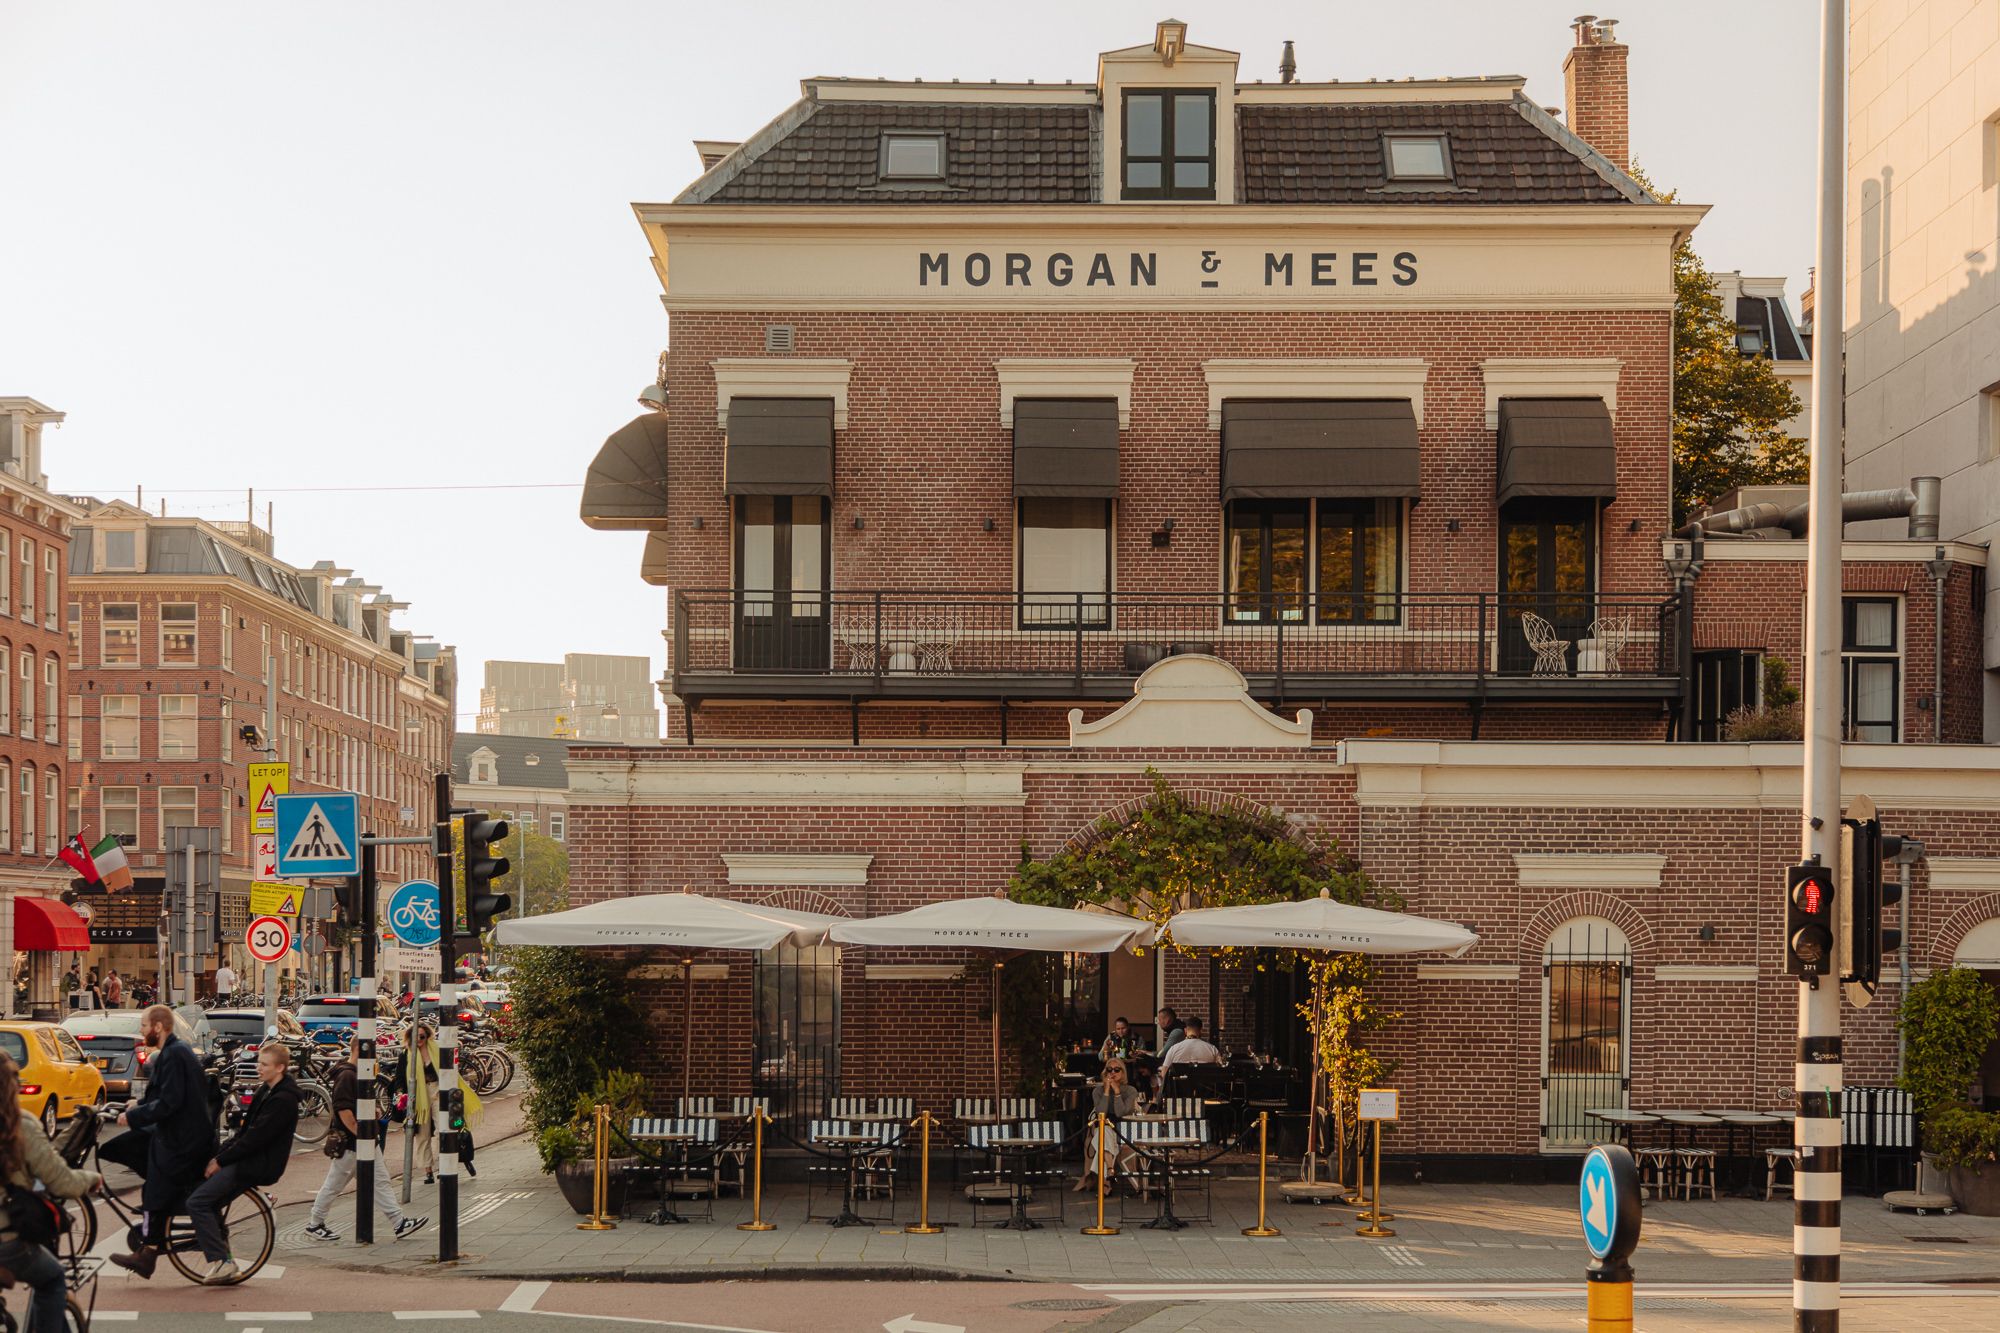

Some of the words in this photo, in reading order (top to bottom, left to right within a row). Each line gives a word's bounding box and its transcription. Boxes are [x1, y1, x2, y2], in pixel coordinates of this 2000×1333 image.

[920, 252, 1157, 287] MORGAN
[1201, 251, 1221, 288] &
[1264, 252, 1418, 287] MEES
[252, 768, 268, 777] LET
[270, 768, 286, 777] OP!
[255, 930, 283, 948] 30
[1341, 935, 1370, 943] MEES
[398, 950, 435, 958] snorfietsen
[399, 964, 435, 972] toegestaan
